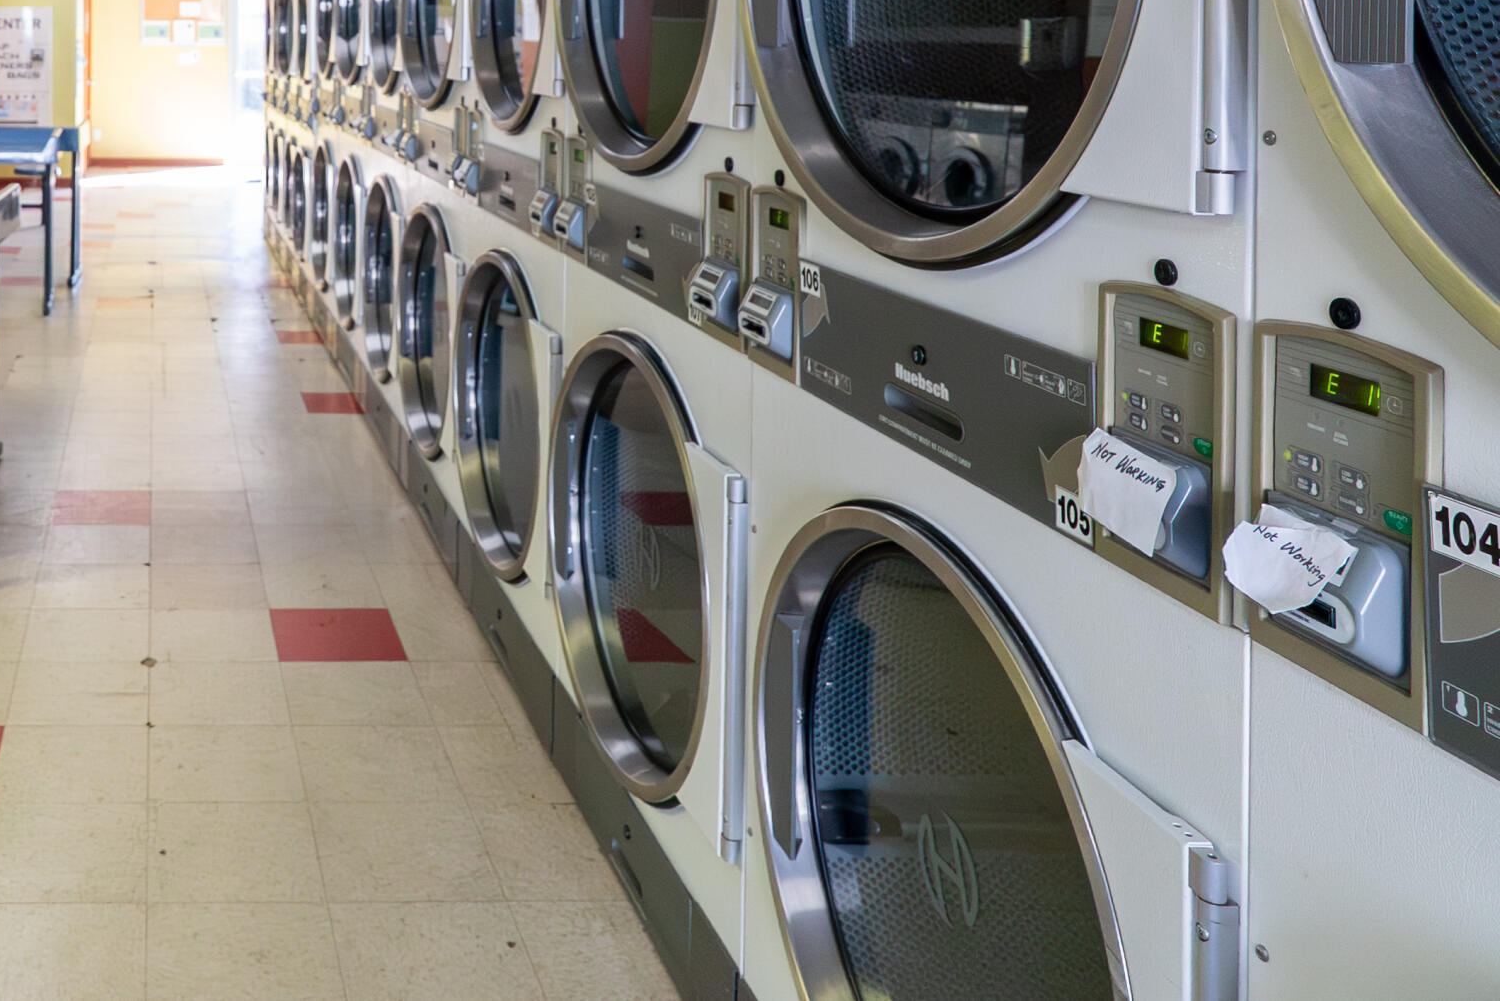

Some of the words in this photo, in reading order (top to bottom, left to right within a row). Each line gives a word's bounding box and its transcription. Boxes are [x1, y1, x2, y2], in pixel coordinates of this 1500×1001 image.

[801, 266, 819, 292] 106
[894, 361, 950, 402] Huebsch
[1090, 441, 1117, 463] NOT
[1114, 454, 1167, 493] WORKING
[1057, 495, 1091, 536] 105
[1435, 505, 1500, 567] 104
[1253, 525, 1279, 543] Not
[1279, 541, 1327, 587] Working
